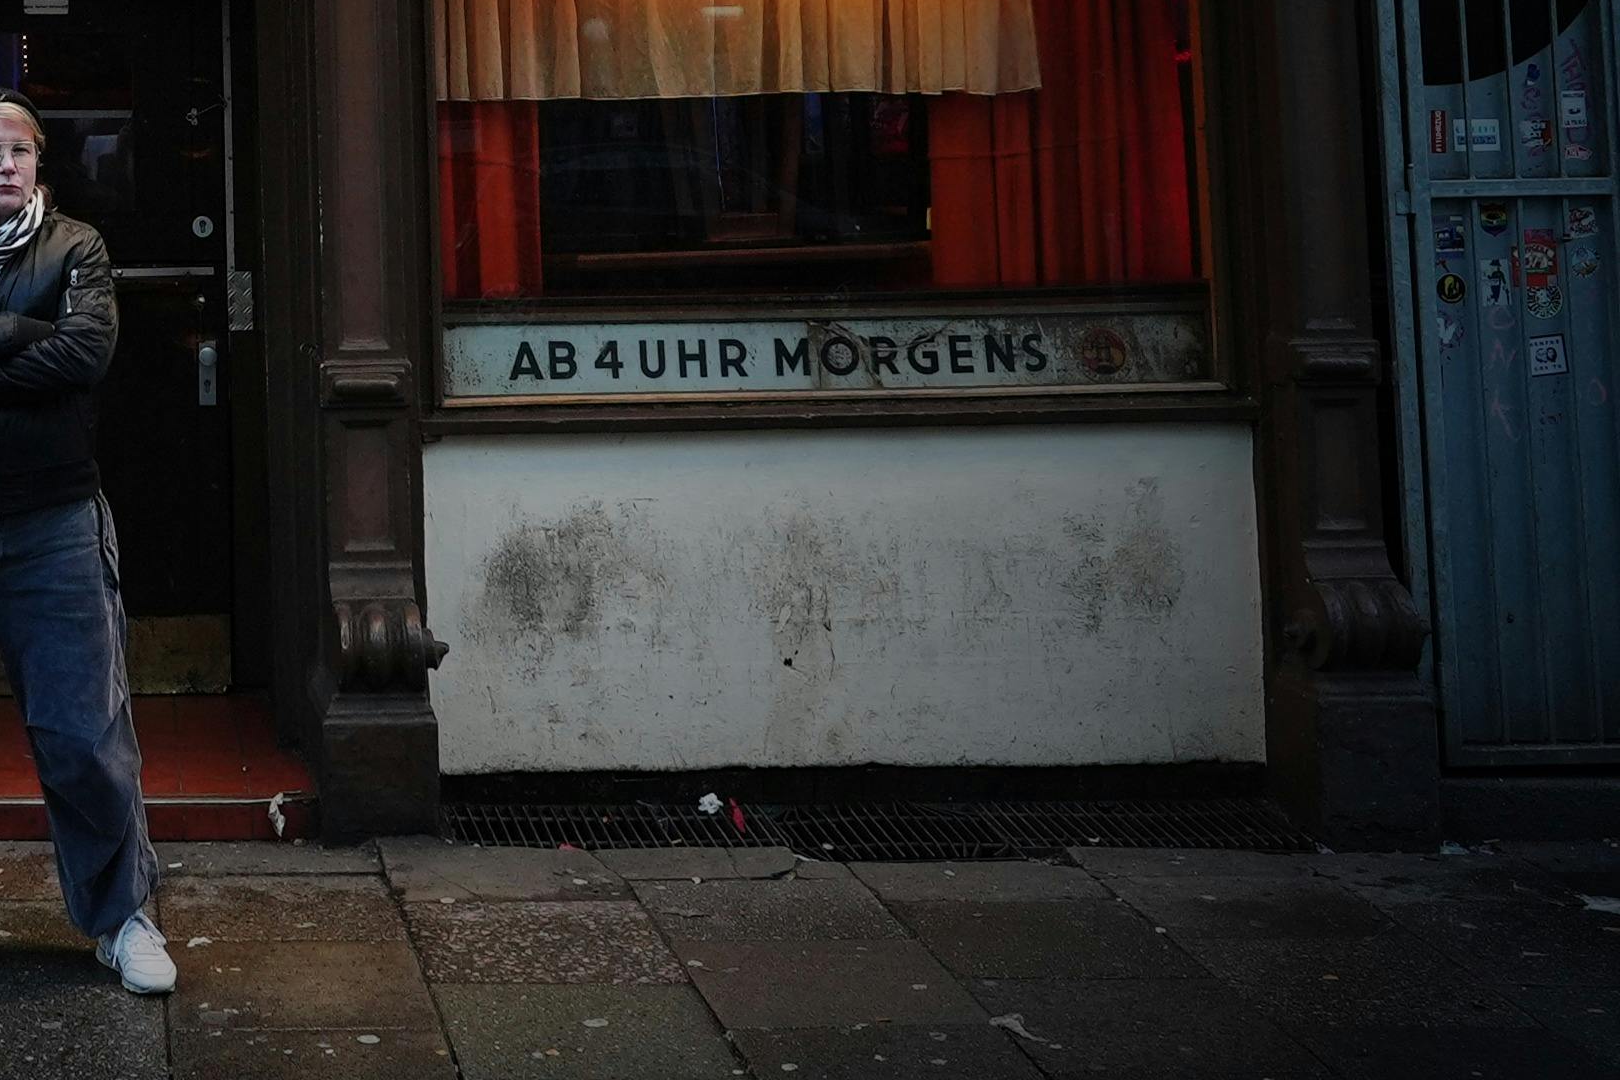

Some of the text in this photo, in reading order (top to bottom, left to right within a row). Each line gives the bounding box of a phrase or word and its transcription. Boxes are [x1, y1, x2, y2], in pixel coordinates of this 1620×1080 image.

[508, 333, 1049, 381] AB 4 UHR MORGENS
